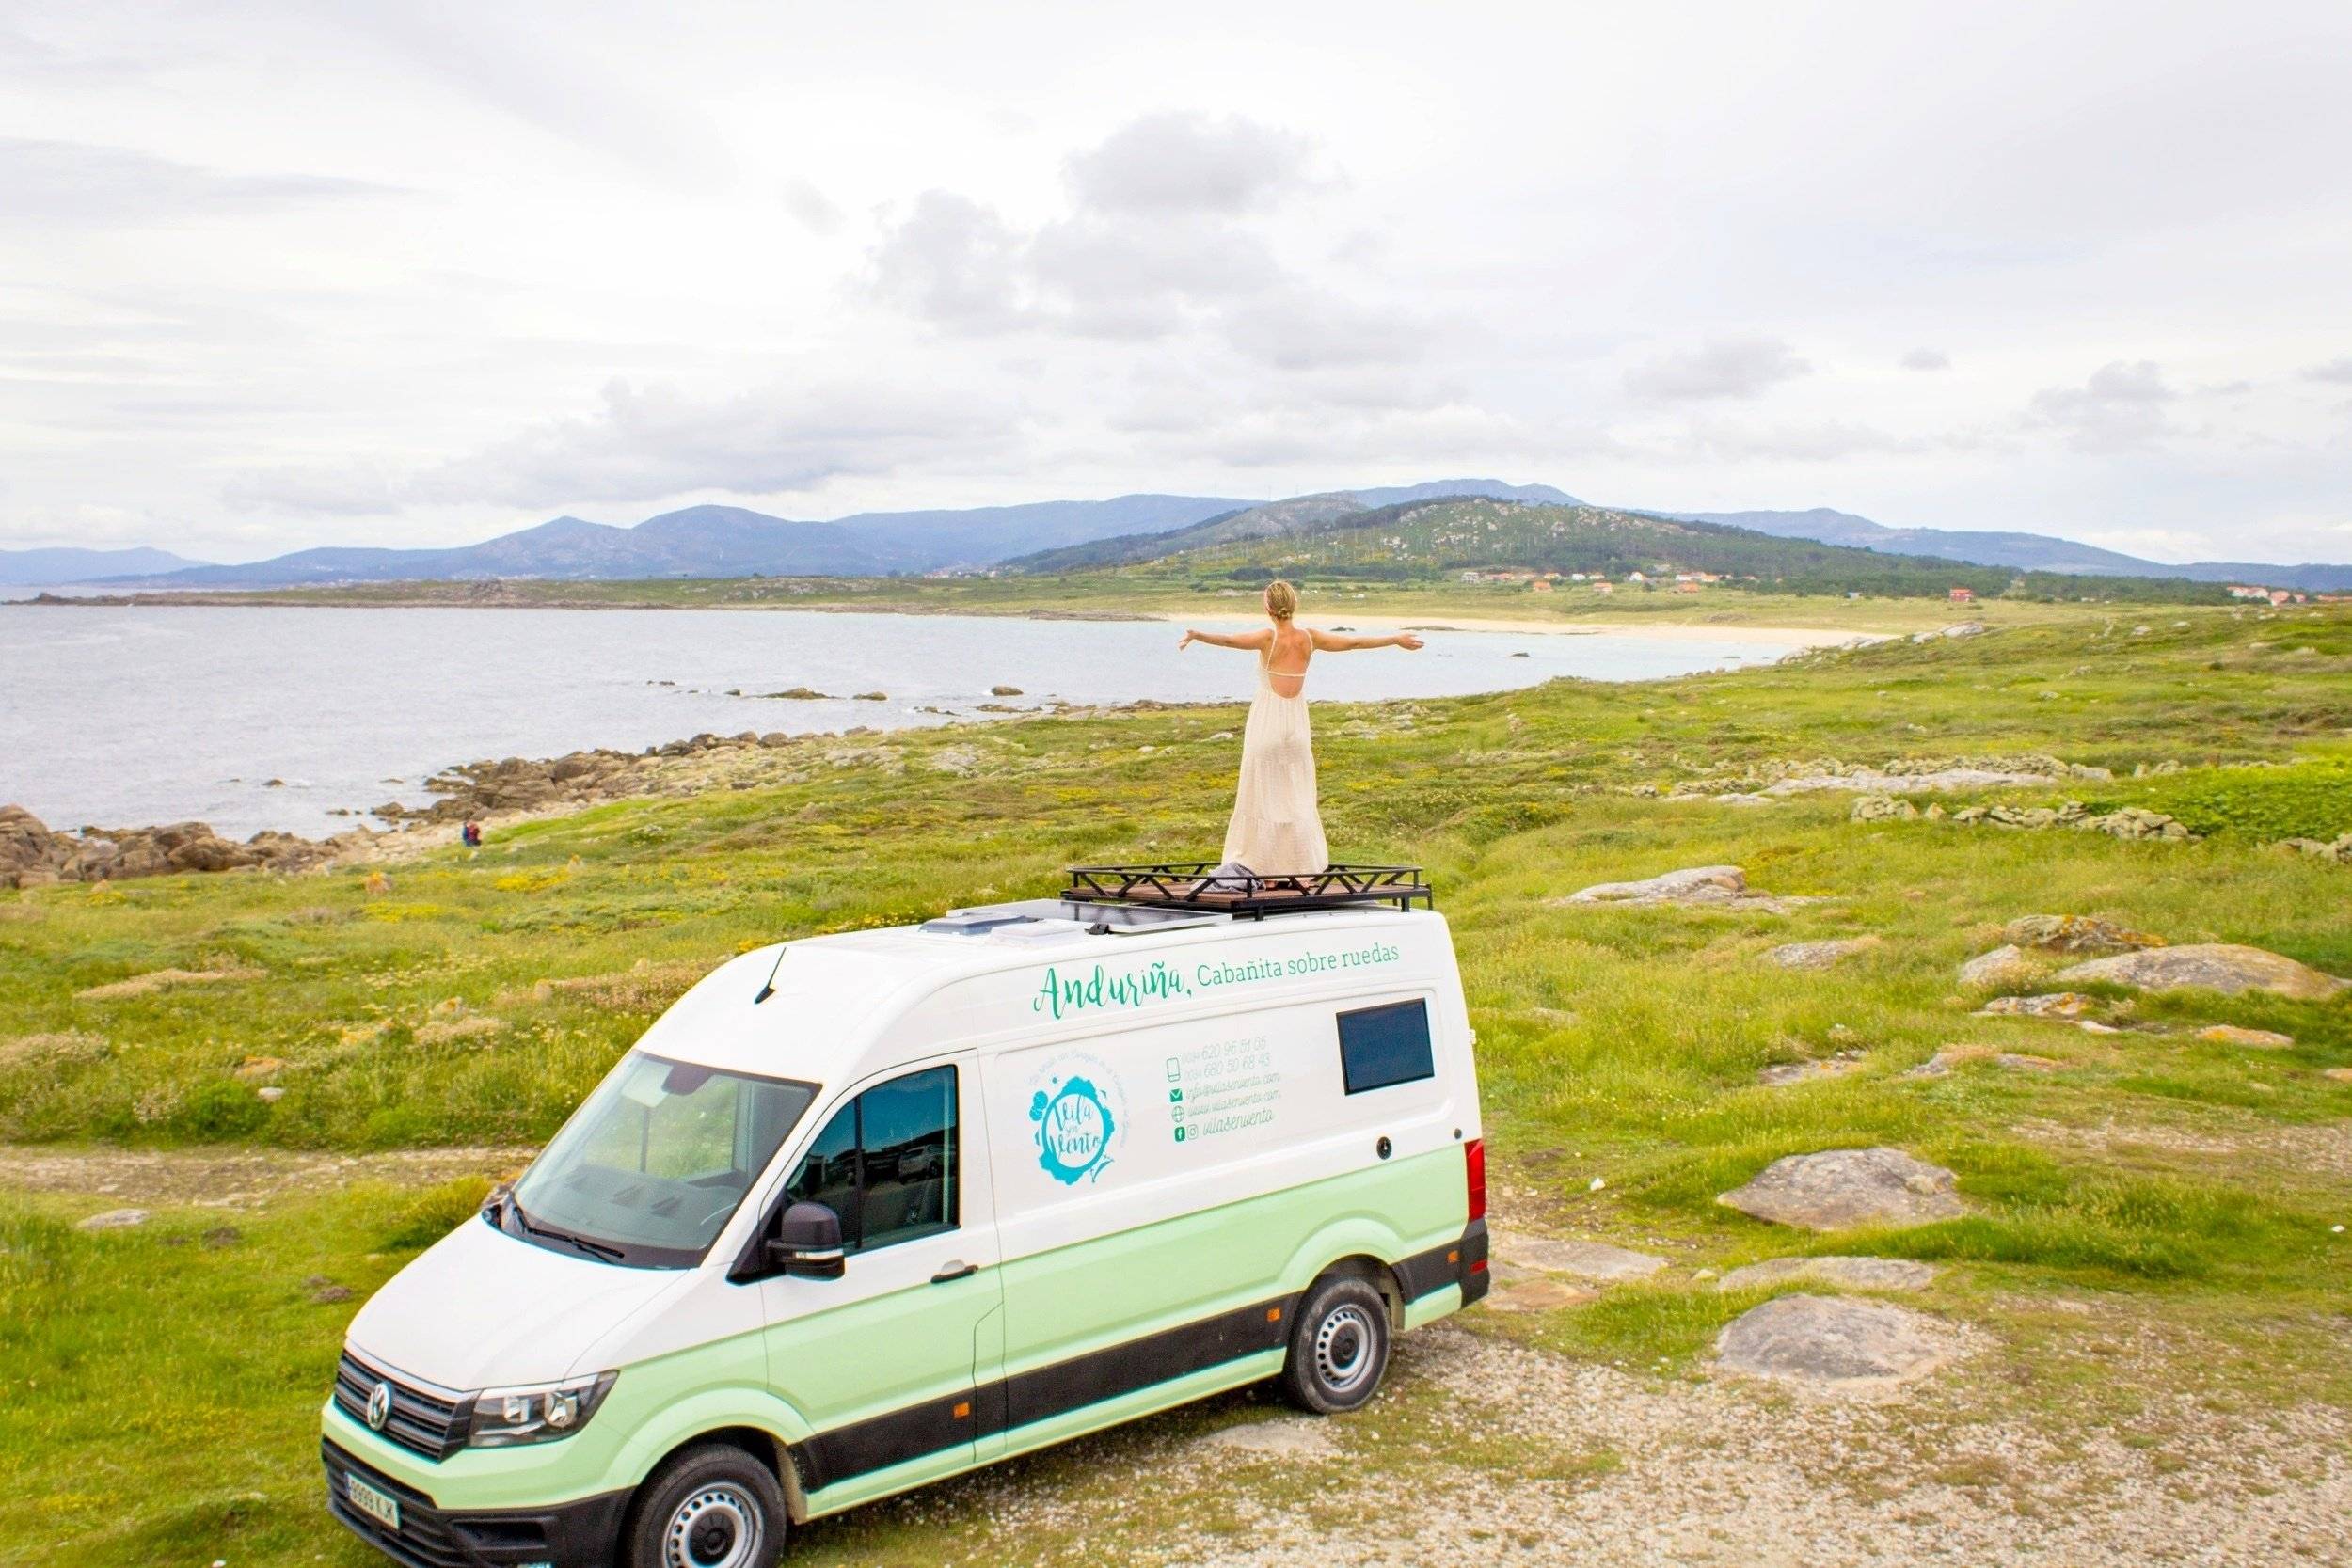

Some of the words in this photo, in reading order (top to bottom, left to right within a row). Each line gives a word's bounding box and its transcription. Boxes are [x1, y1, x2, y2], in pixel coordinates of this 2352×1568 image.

[1033, 961, 1192, 1020] Anduriña,
[1196, 958, 1283, 987] Cabañita
[1287, 951, 1337, 975] sobre
[1342, 942, 1400, 967] ruedas
